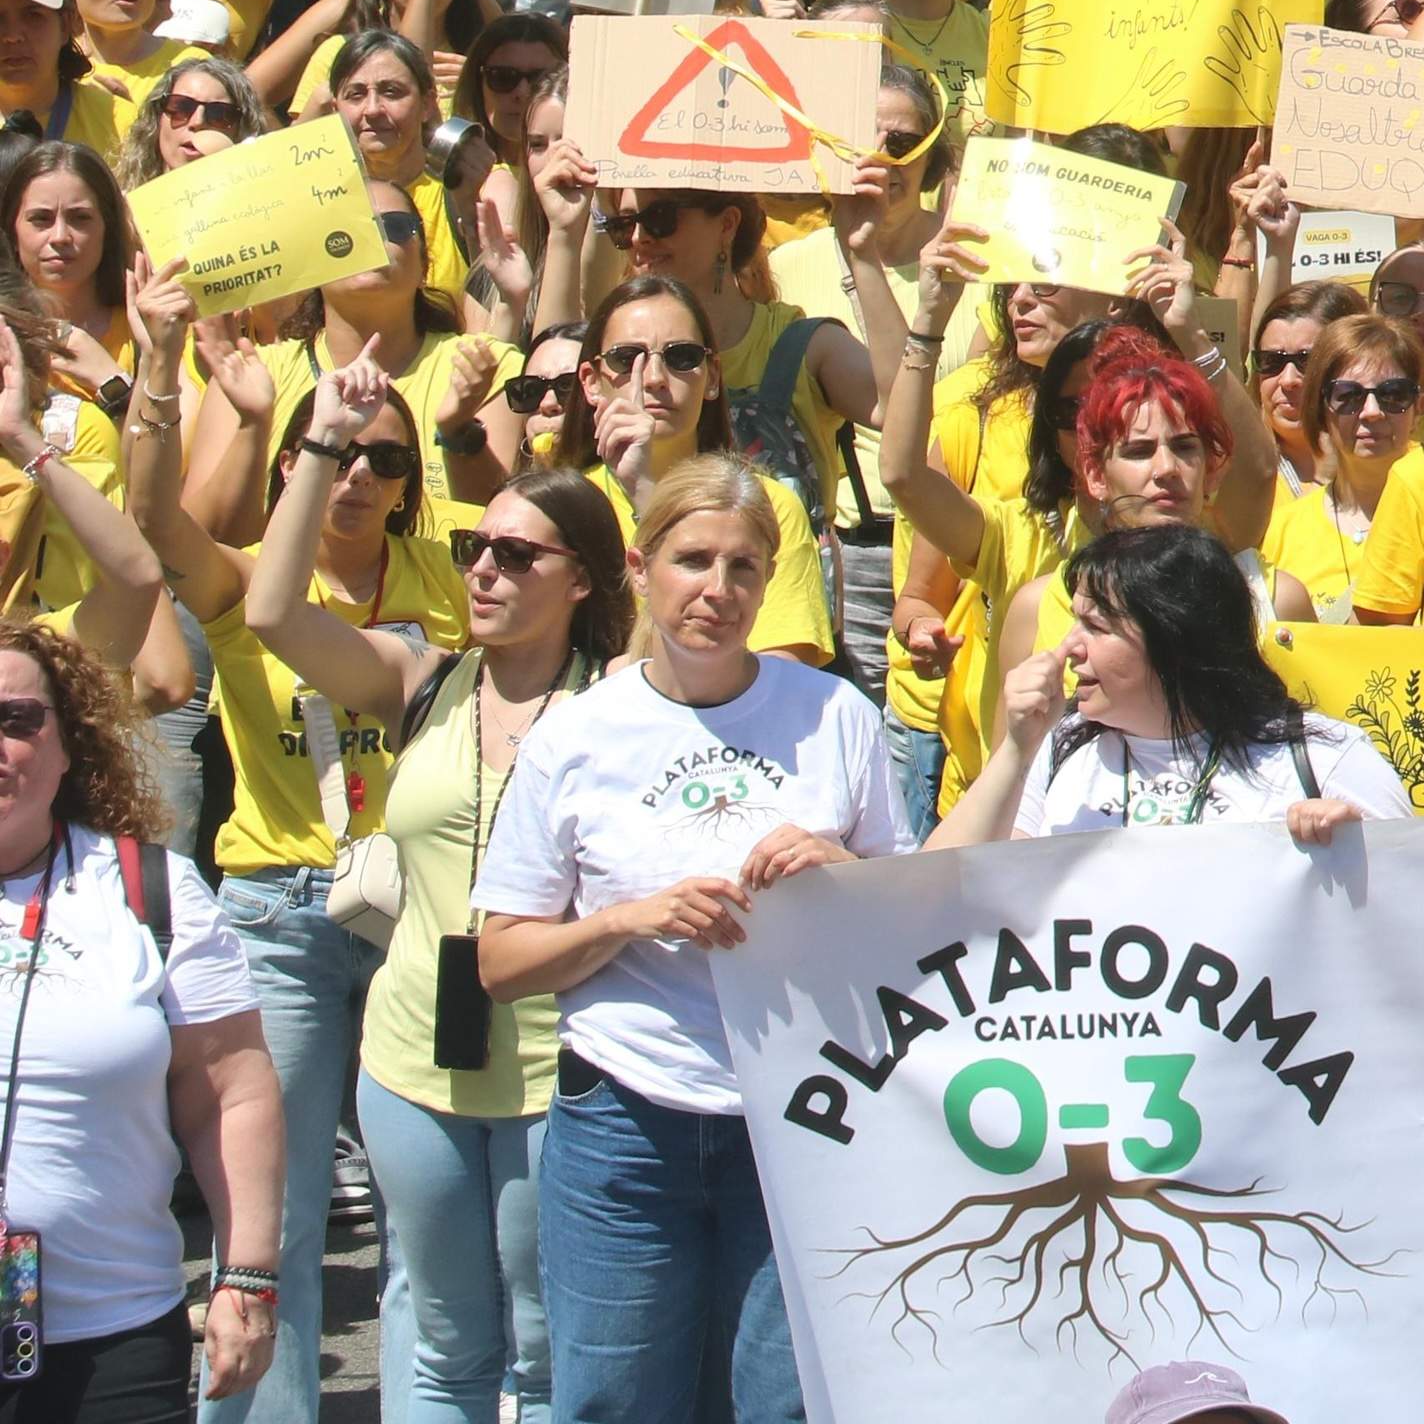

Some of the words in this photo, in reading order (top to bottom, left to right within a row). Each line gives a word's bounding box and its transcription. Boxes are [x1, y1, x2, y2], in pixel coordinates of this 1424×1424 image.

[1318, 30, 1385, 56] ESCOLA
[193, 252, 237, 277] QUINA
[239, 246, 259, 263] ÉS
[261, 241, 280, 255] LA
[202, 263, 282, 297] PRIORITAT?
[641, 747, 786, 810] PLATAFORMA
[783, 919, 1354, 1145] PLATAFORMA
[974, 1013, 1162, 1041] CATALUNYA
[944, 1053, 1202, 1175] 0-3
